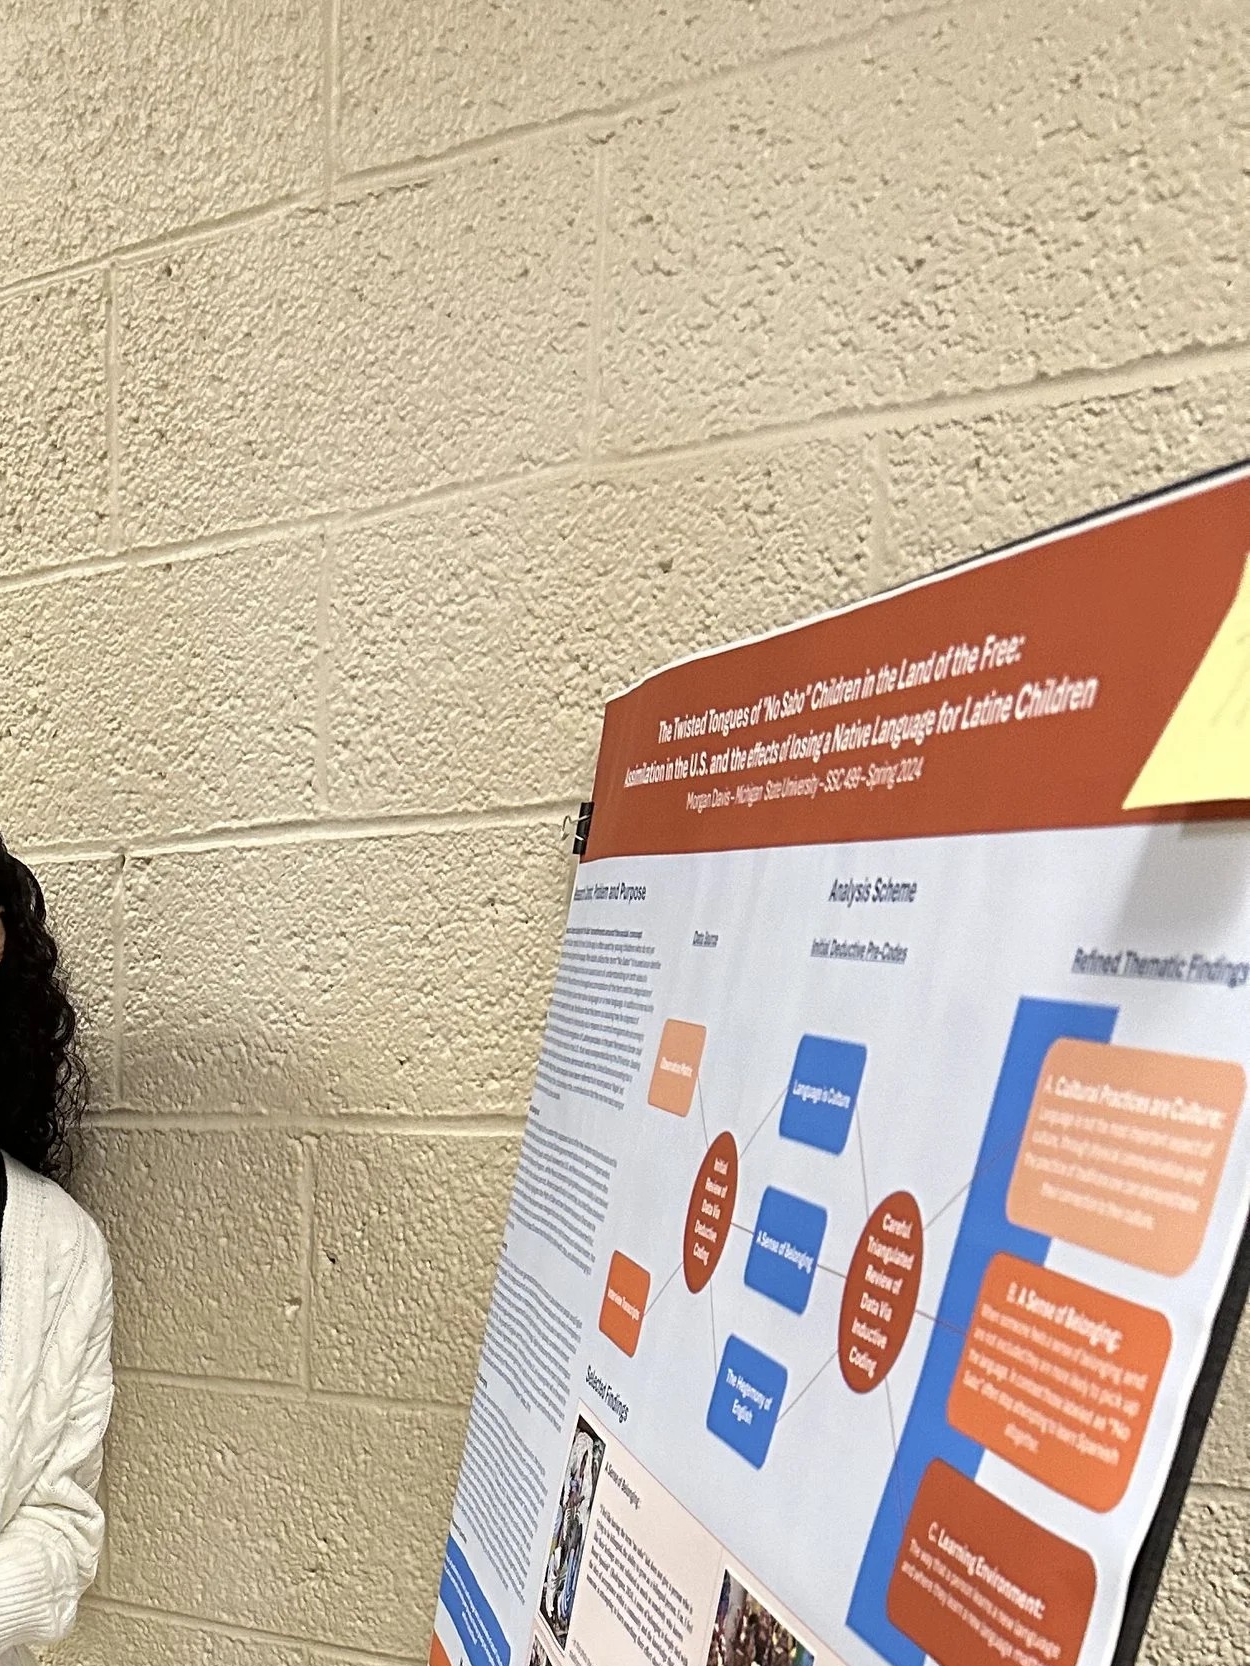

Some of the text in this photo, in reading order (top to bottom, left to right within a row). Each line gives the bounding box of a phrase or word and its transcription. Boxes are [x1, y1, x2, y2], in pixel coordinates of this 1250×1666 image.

[658, 634, 1027, 744] The Twisted Tongues of "No Sabo" Children in the Land of the Free:
[624, 675, 1099, 788] Assimilation in the U.S. and the effects of losing a Native Language for Latine Children
[686, 791, 711, 813] Morgan
[712, 788, 730, 808] Davis
[763, 780, 782, 800] State
[781, 773, 820, 798] University
[866, 762, 898, 791] Spring
[896, 755, 925, 783] 2024
[620, 882, 647, 904] Purpose
[829, 877, 918, 908] Analysis Scheme
[692, 930, 704, 947] Data
[810, 938, 908, 964] Initial Deductive Pre-Codes
[1071, 945, 1250, 988] Refined Thematic Findings
[792, 1079, 823, 1105] Language
[827, 1087, 851, 1109] Culture
[1055, 1075, 1101, 1103] Cultural
[1100, 1083, 1150, 1114] Practices
[705, 1177, 722, 1196] Review
[701, 1199, 713, 1216] Data
[694, 1219, 717, 1243] Deductive
[882, 1213, 913, 1240] Careful
[693, 1242, 710, 1266] Coding
[762, 1232, 779, 1253] Sense
[778, 1242, 786, 1256] of
[784, 1242, 814, 1274] Belonging
[867, 1235, 915, 1270] Triangulated
[865, 1264, 903, 1295] Review of
[860, 1292, 893, 1322] Data Via
[1025, 1289, 1056, 1320] Sense
[1053, 1305, 1068, 1324] of
[1064, 1306, 1123, 1354] Belonging:
[851, 1317, 888, 1350] Inductive
[849, 1345, 877, 1379] Coding
[585, 1365, 630, 1424] Selected Findings
[725, 1368, 774, 1412] The Hegemony of
[732, 1399, 754, 1425] English
[937, 1528, 978, 1576] Learning
[975, 1555, 1046, 1620] Environment:
